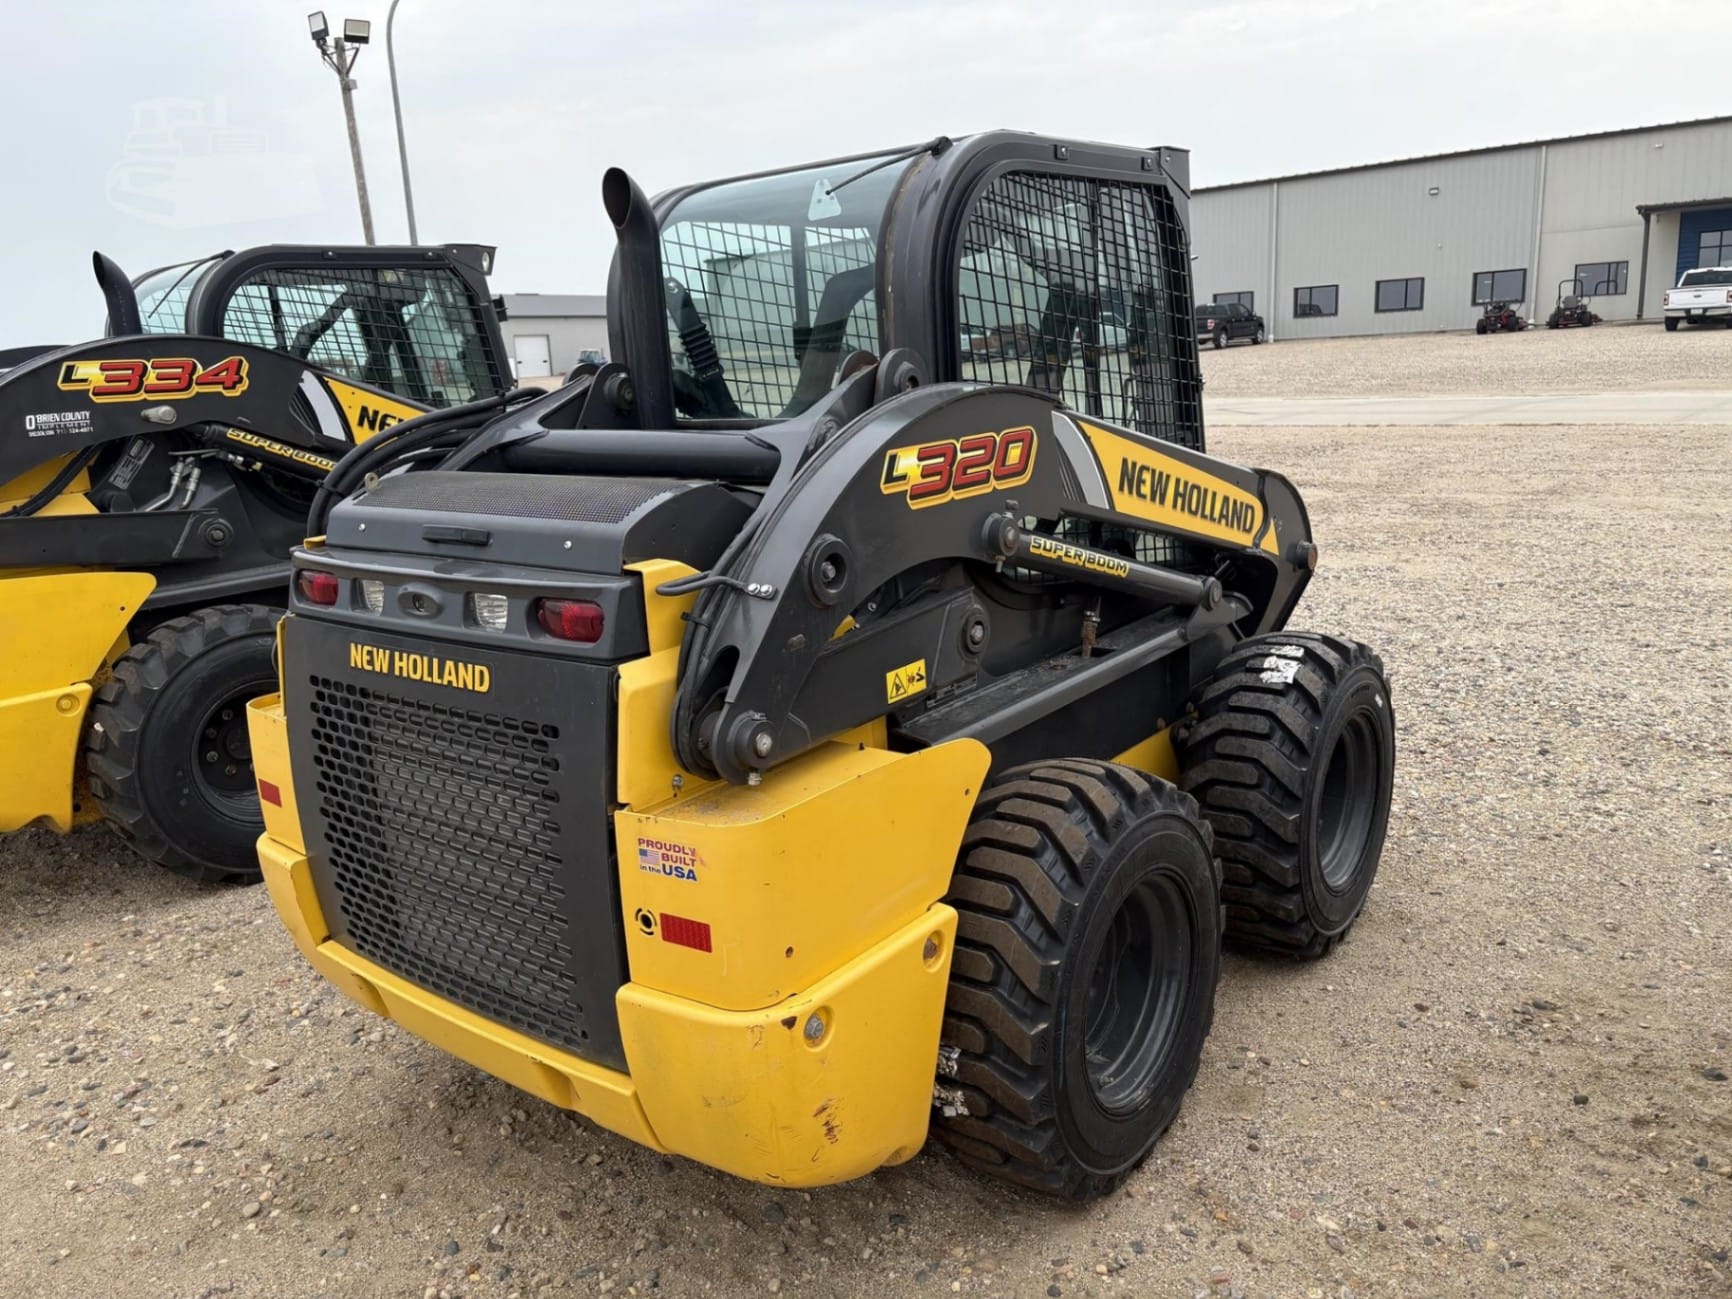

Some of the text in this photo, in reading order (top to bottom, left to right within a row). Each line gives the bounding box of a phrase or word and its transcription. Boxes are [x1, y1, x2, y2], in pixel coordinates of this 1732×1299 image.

[58, 357, 249, 403] L334
[61, 411, 90, 421] COUNTY
[357, 405, 405, 431] NE
[881, 426, 1037, 509] L320
[1118, 456, 1255, 534] NEW HOLLAND
[350, 642, 490, 693] NEW HOLLAND
[638, 837, 696, 857] PROUDLY
[661, 852, 697, 867] BUILT
[648, 865, 661, 874] the
[662, 863, 697, 882] USA
